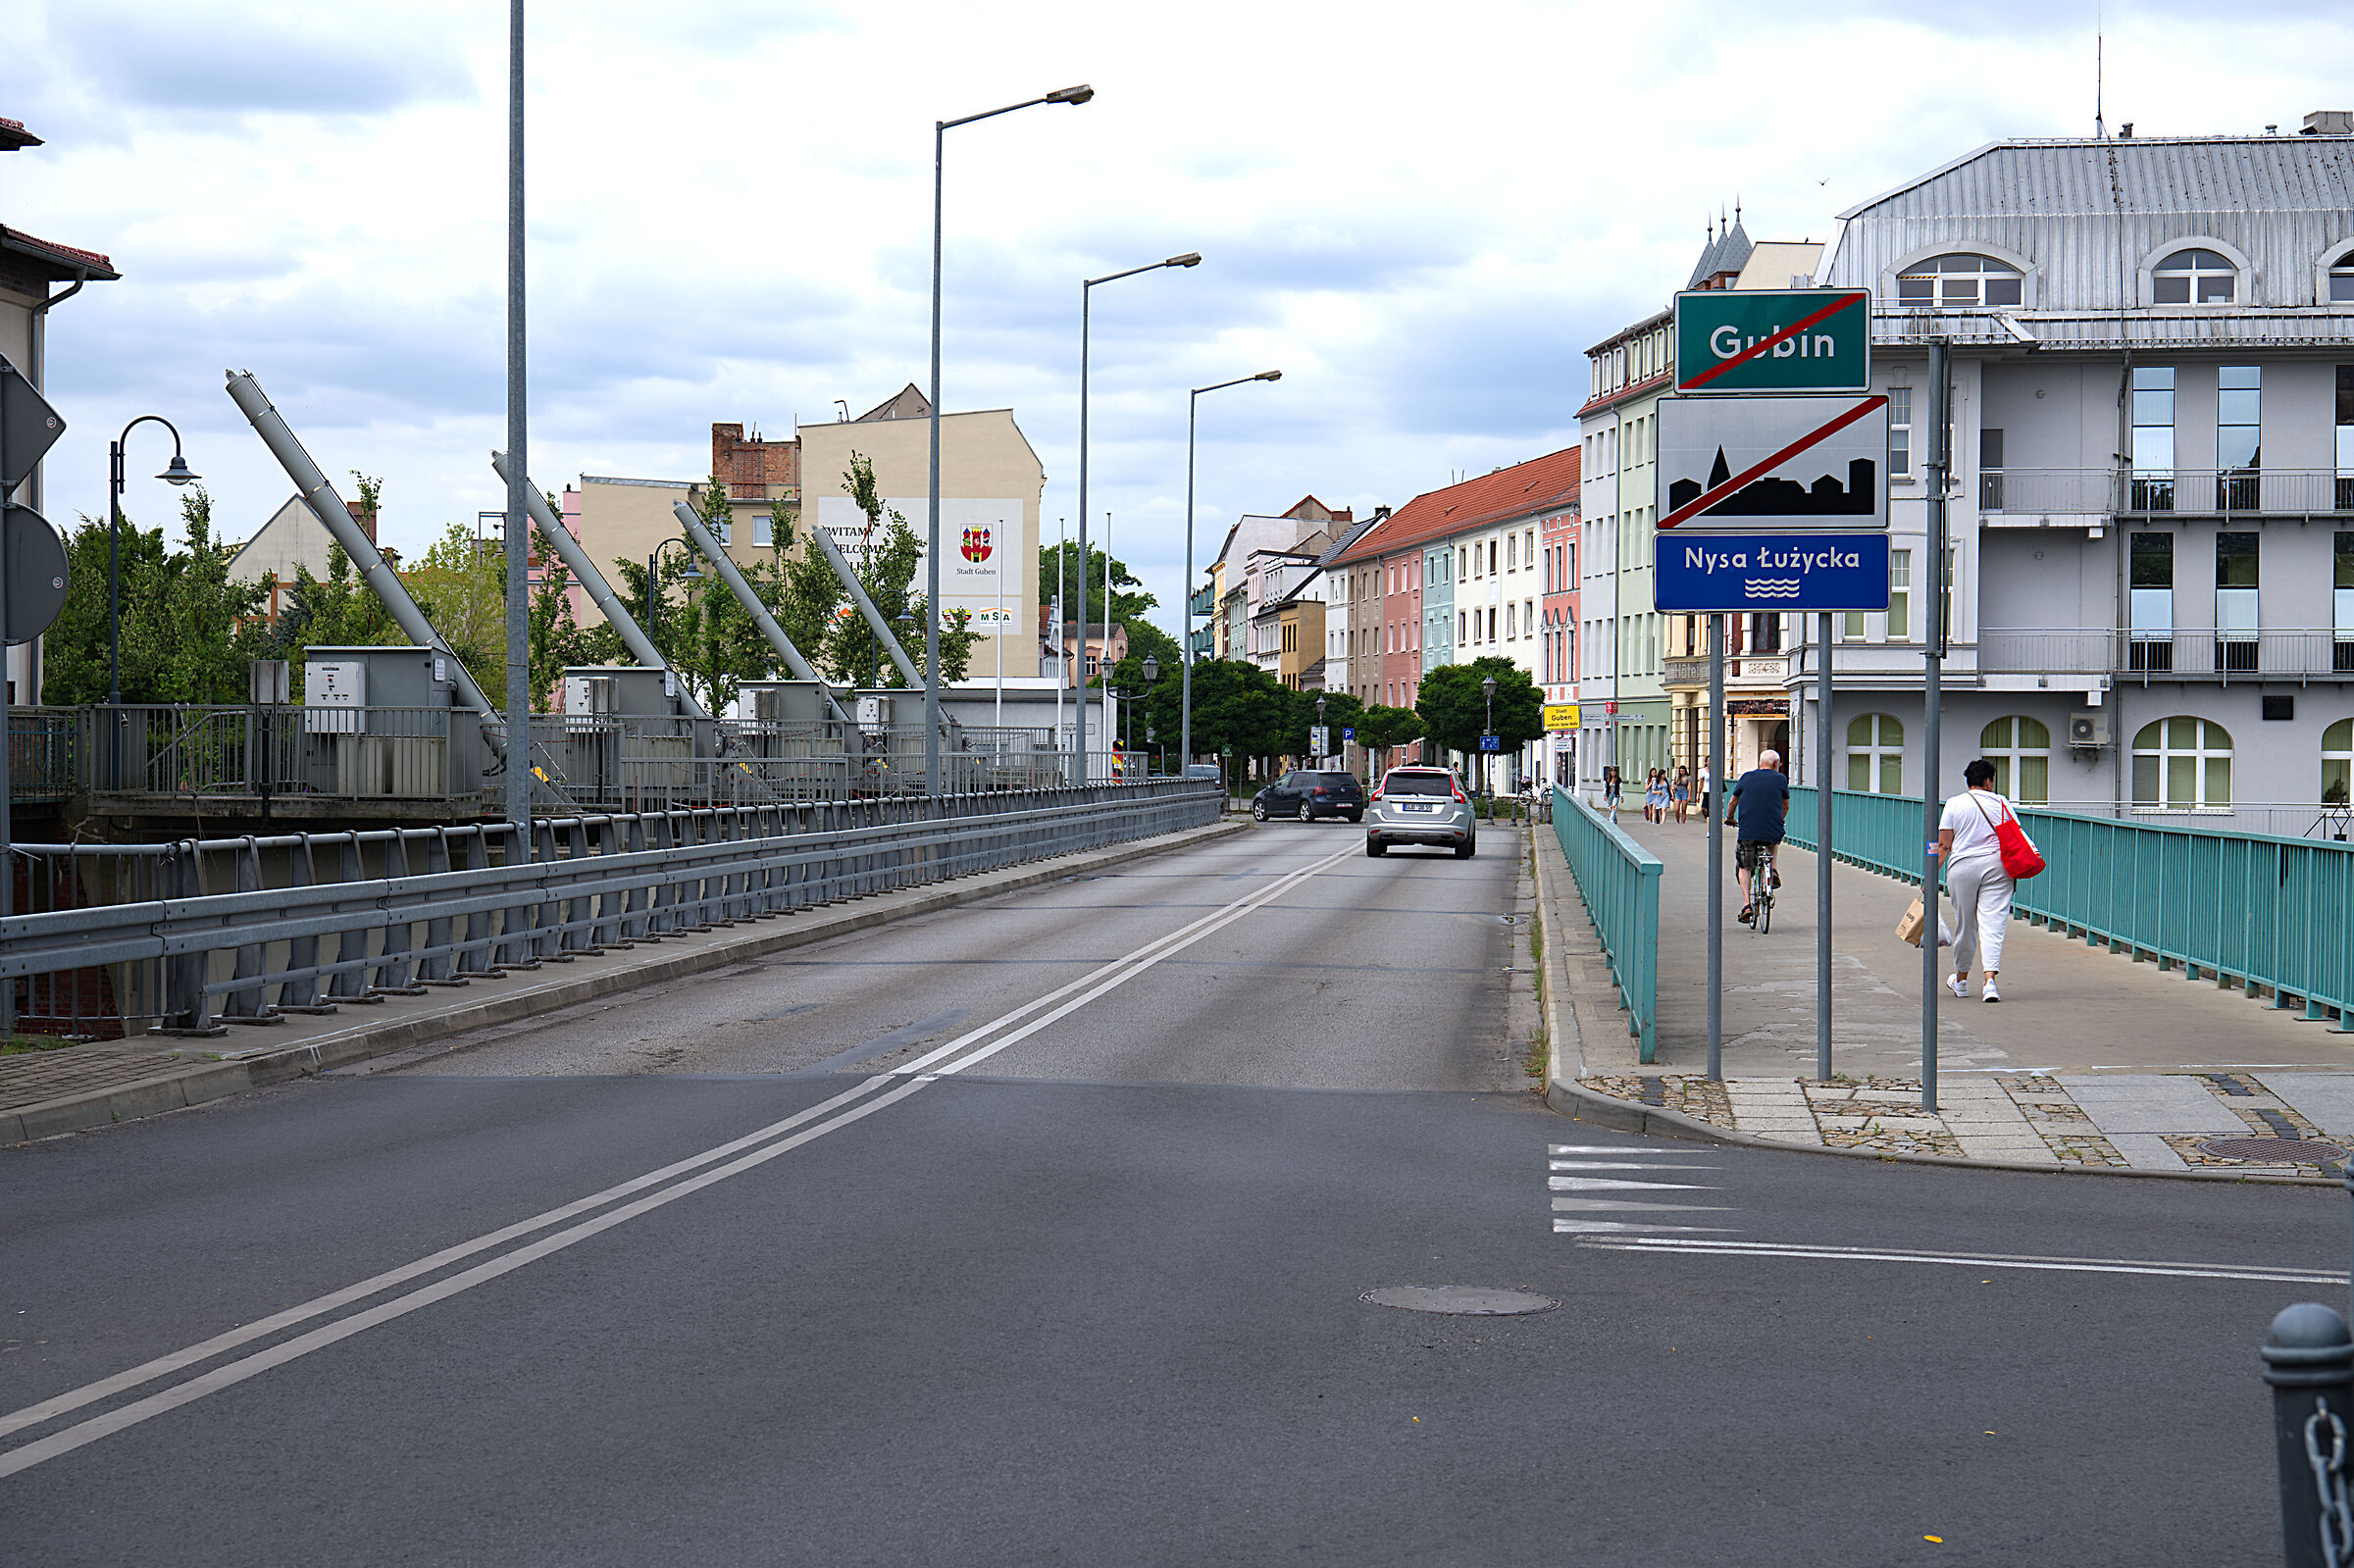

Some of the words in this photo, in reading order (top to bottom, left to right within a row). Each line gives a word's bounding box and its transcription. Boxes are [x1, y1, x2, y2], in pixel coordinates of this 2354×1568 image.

[1710, 325, 1834, 359] Gubin
[1685, 547, 1747, 575] Nysa
[1757, 546, 1860, 575] Łużycka
[981, 612, 1009, 621] MSA
[1345, 730, 1352, 738] P
